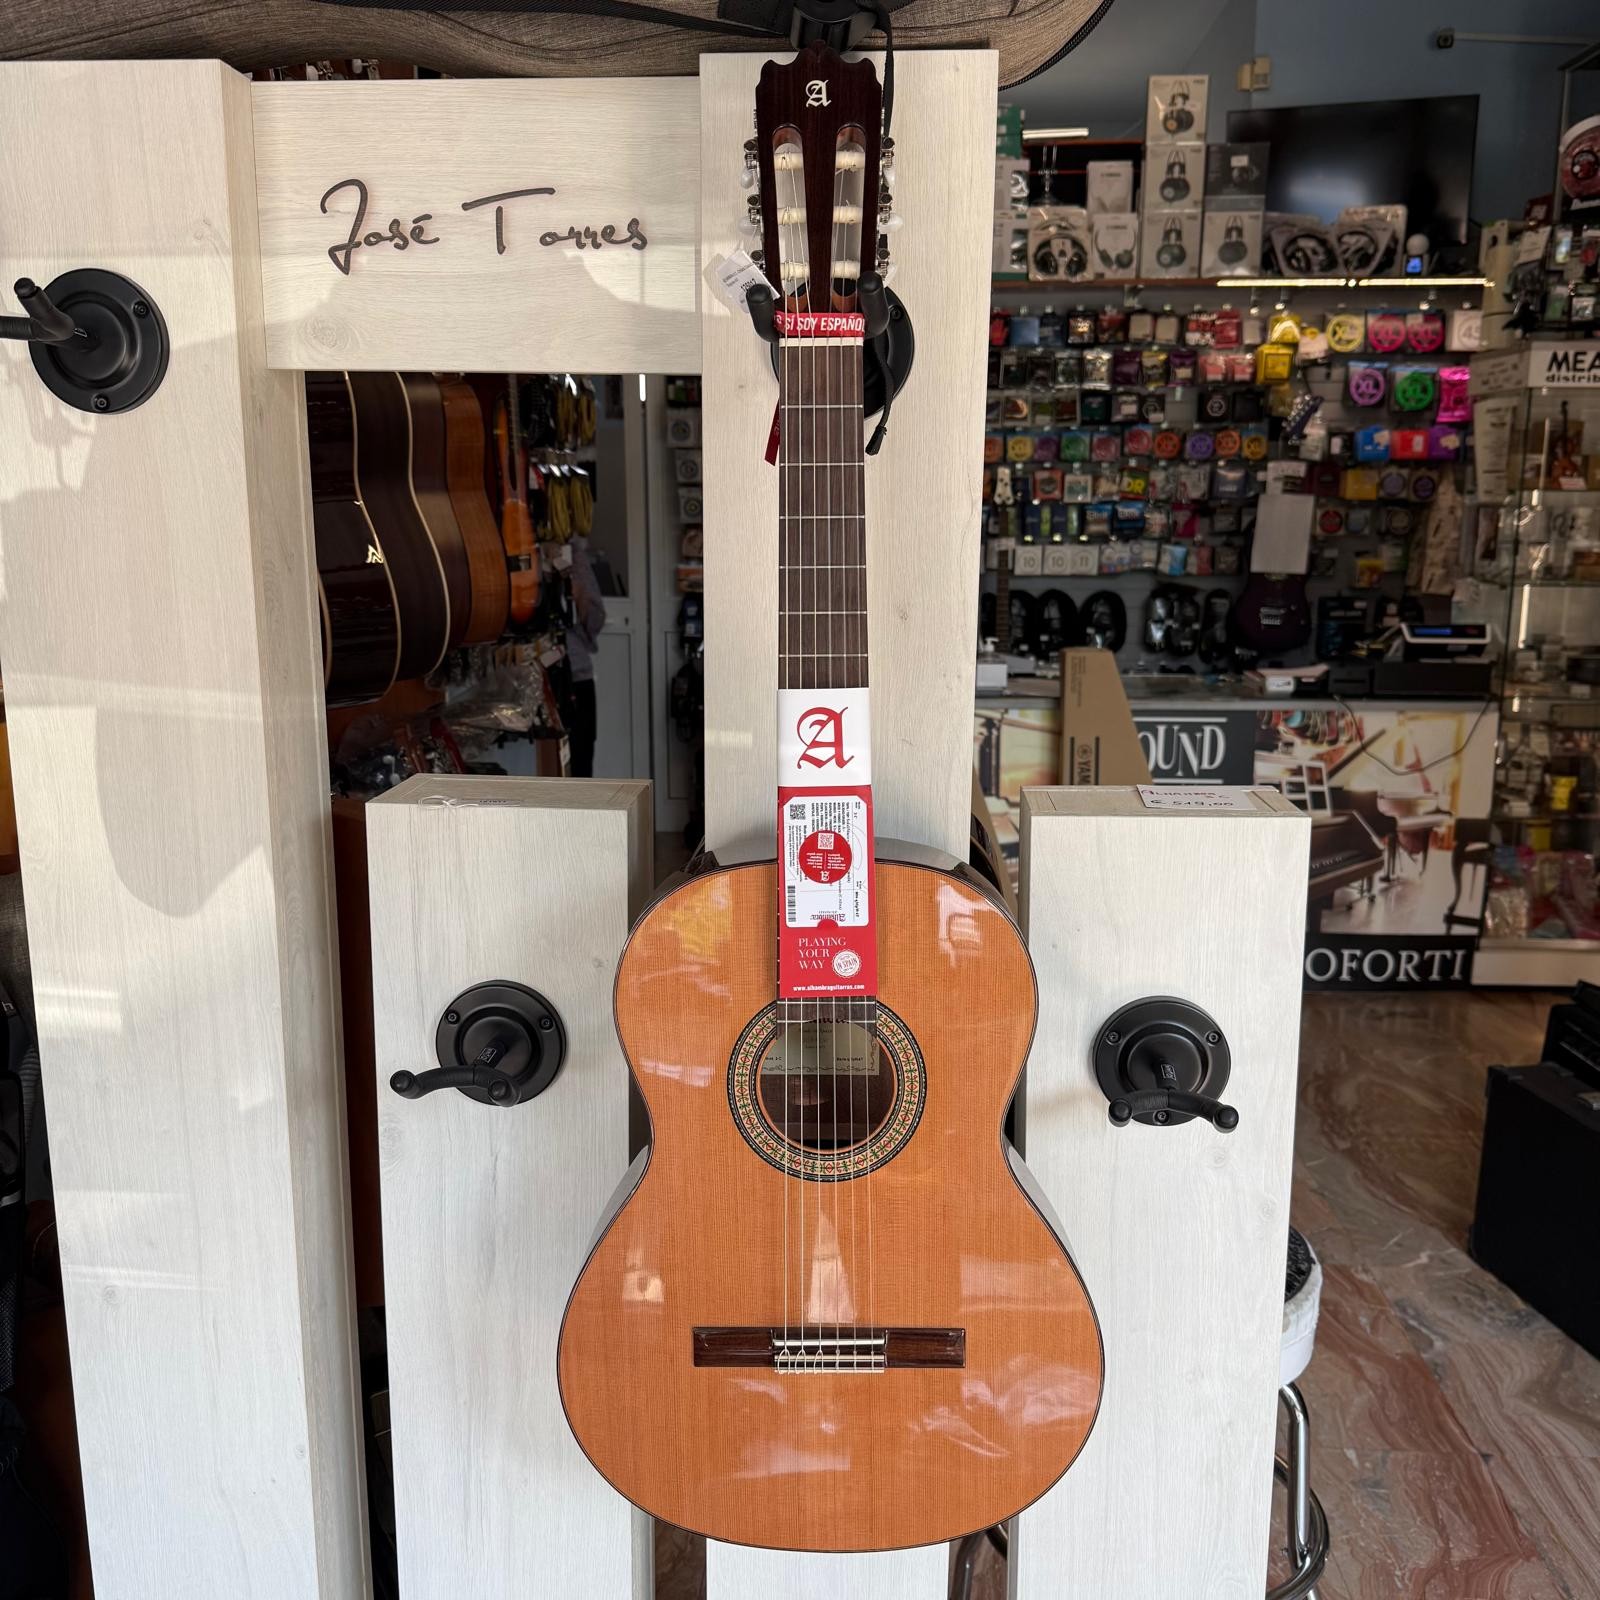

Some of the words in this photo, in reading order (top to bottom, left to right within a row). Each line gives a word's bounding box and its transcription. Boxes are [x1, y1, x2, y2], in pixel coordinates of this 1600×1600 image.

[805, 79, 832, 108] A
[319, 178, 440, 275] José
[461, 187, 648, 255] Torres
[797, 317, 818, 331] SOY
[1124, 478, 1144, 494] DR
[1022, 555, 1035, 567] 10
[1051, 556, 1065, 568] 10
[796, 706, 855, 770] A
[798, 936, 846, 947] PLAYING
[798, 948, 830, 958] YOUR
[798, 959, 825, 970] WAY
[1304, 948, 1467, 982] OFORTI
